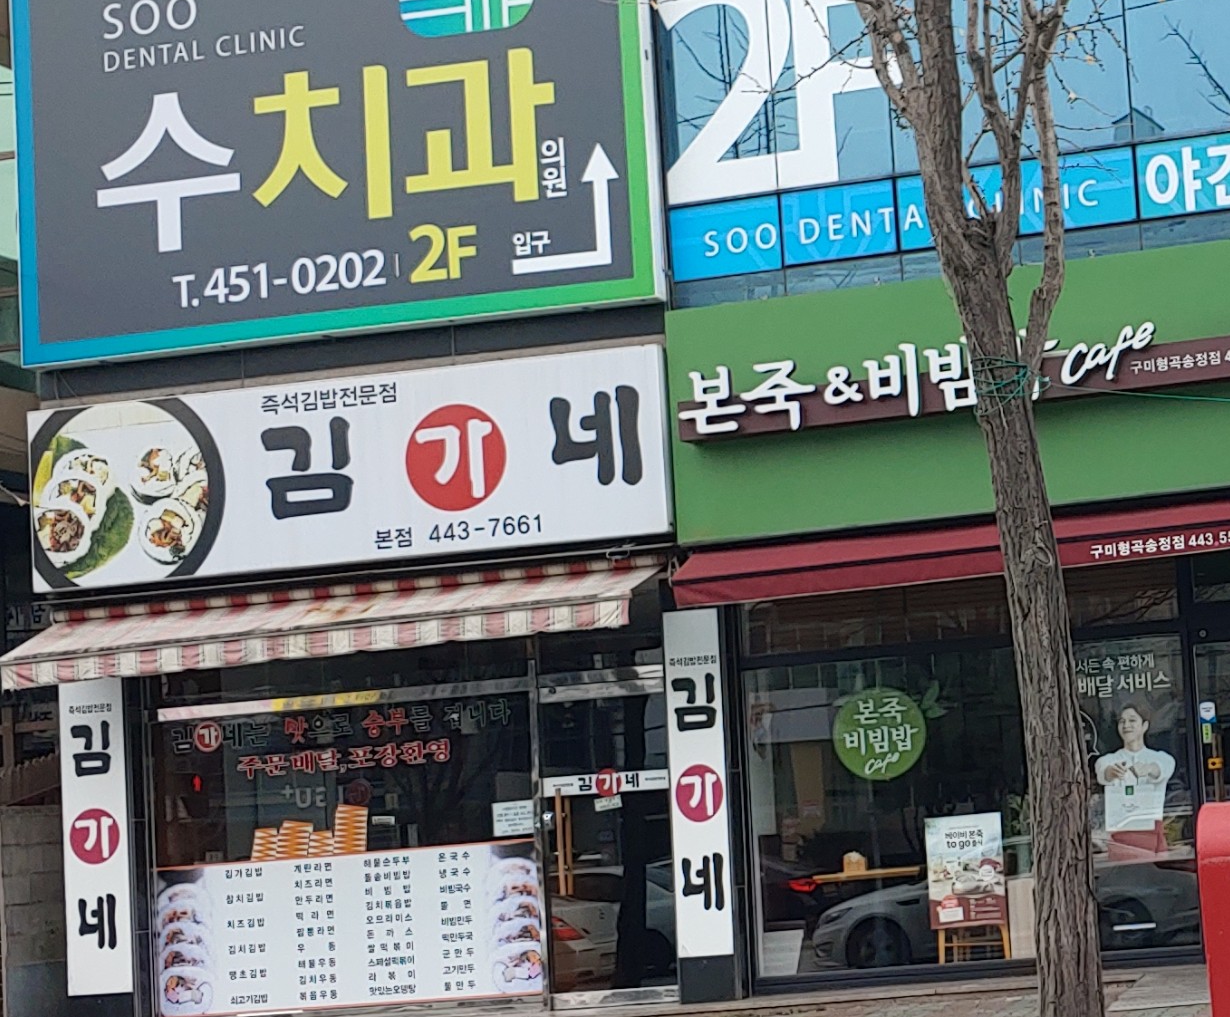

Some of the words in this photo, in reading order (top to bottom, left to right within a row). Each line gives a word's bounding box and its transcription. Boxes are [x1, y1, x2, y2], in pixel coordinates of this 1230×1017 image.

[103, 39, 204, 73] DENTAL
[215, 25, 306, 60] CLINIC
[97, 47, 556, 253] 수치과
[541, 136, 567, 199] 의원
[409, 223, 478, 284] 2F
[512, 231, 551, 256] 입구
[704, 222, 778, 257] SOO
[1061, 321, 1156, 385] cafe
[1130, 351, 1221, 375] 구미형곡송정점
[260, 382, 398, 415] 즉석김밥전문점
[374, 527, 413, 551] 본점
[429, 513, 543, 544] 443-7661
[1090, 535, 1185, 559] 구미형곡송정점
[1102, 656, 1115, 672] 속
[1117, 652, 1155, 670] 편하게
[1077, 674, 1114, 698] 배달
[1117, 670, 1172, 694] 서비스
[361, 705, 434, 738] 승부를
[853, 696, 907, 725] 본죽
[843, 724, 919, 756] 비빔밥
[578, 773, 639, 795] 김가네
[227, 918, 265, 929] 치즈김밥
[228, 943, 266, 955] 김치김밥
